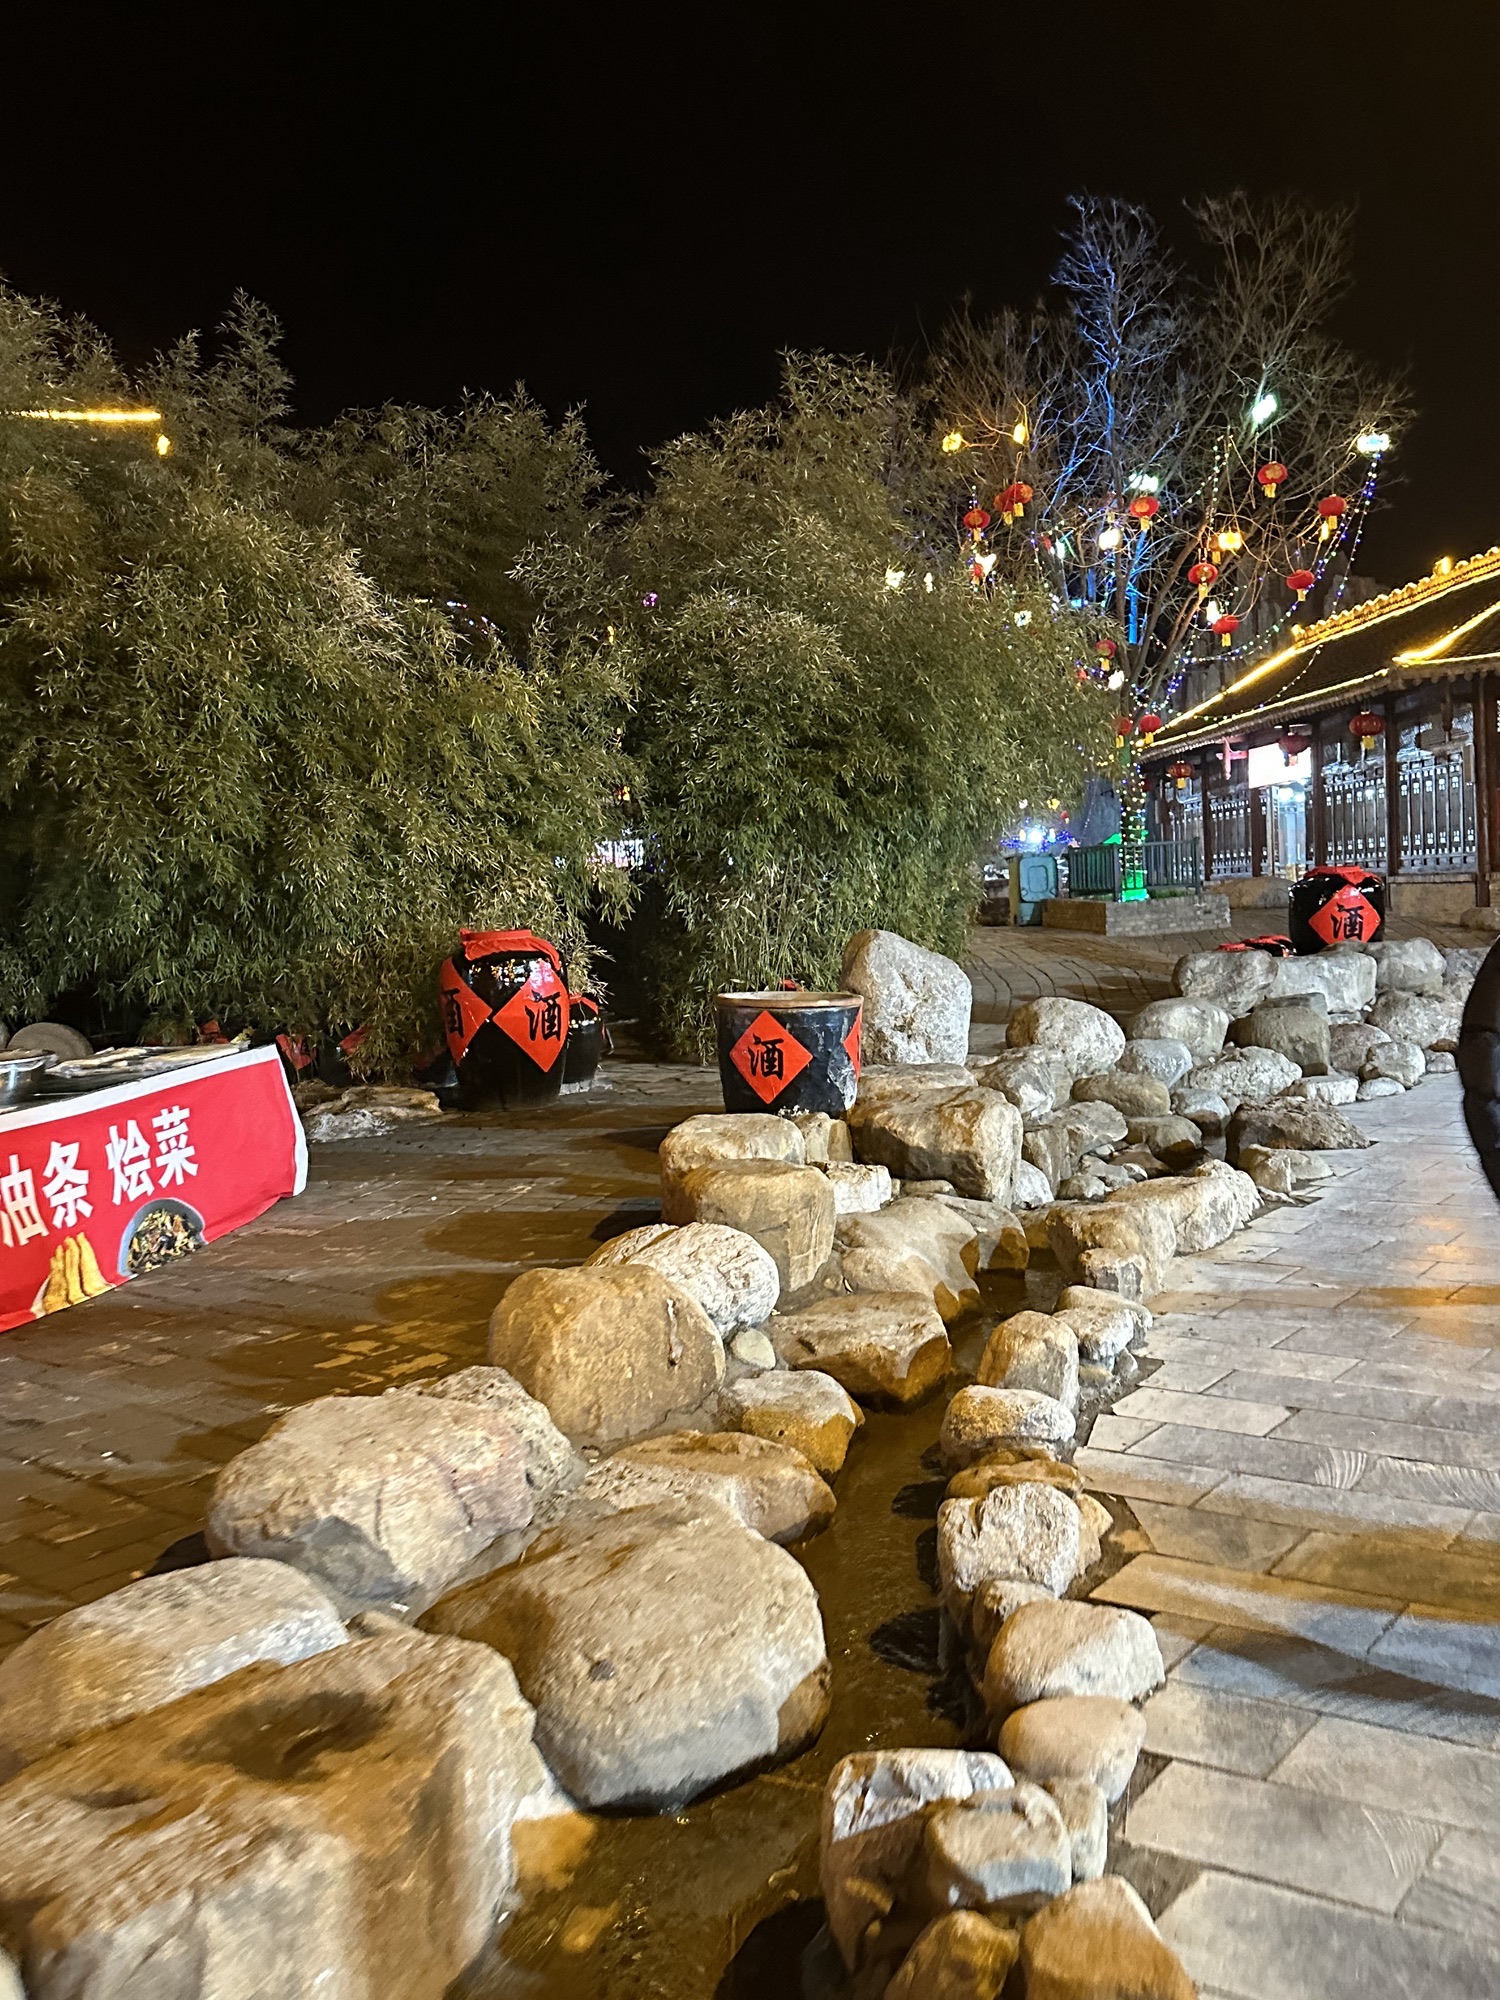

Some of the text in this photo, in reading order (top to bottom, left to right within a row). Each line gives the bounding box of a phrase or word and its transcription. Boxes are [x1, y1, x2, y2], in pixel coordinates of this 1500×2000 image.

[1331, 903, 1365, 941] 酒
[525, 989, 562, 1042] 酒
[747, 1033, 785, 1081] 酒
[0, 1105, 199, 1248] 油条 烩菜
